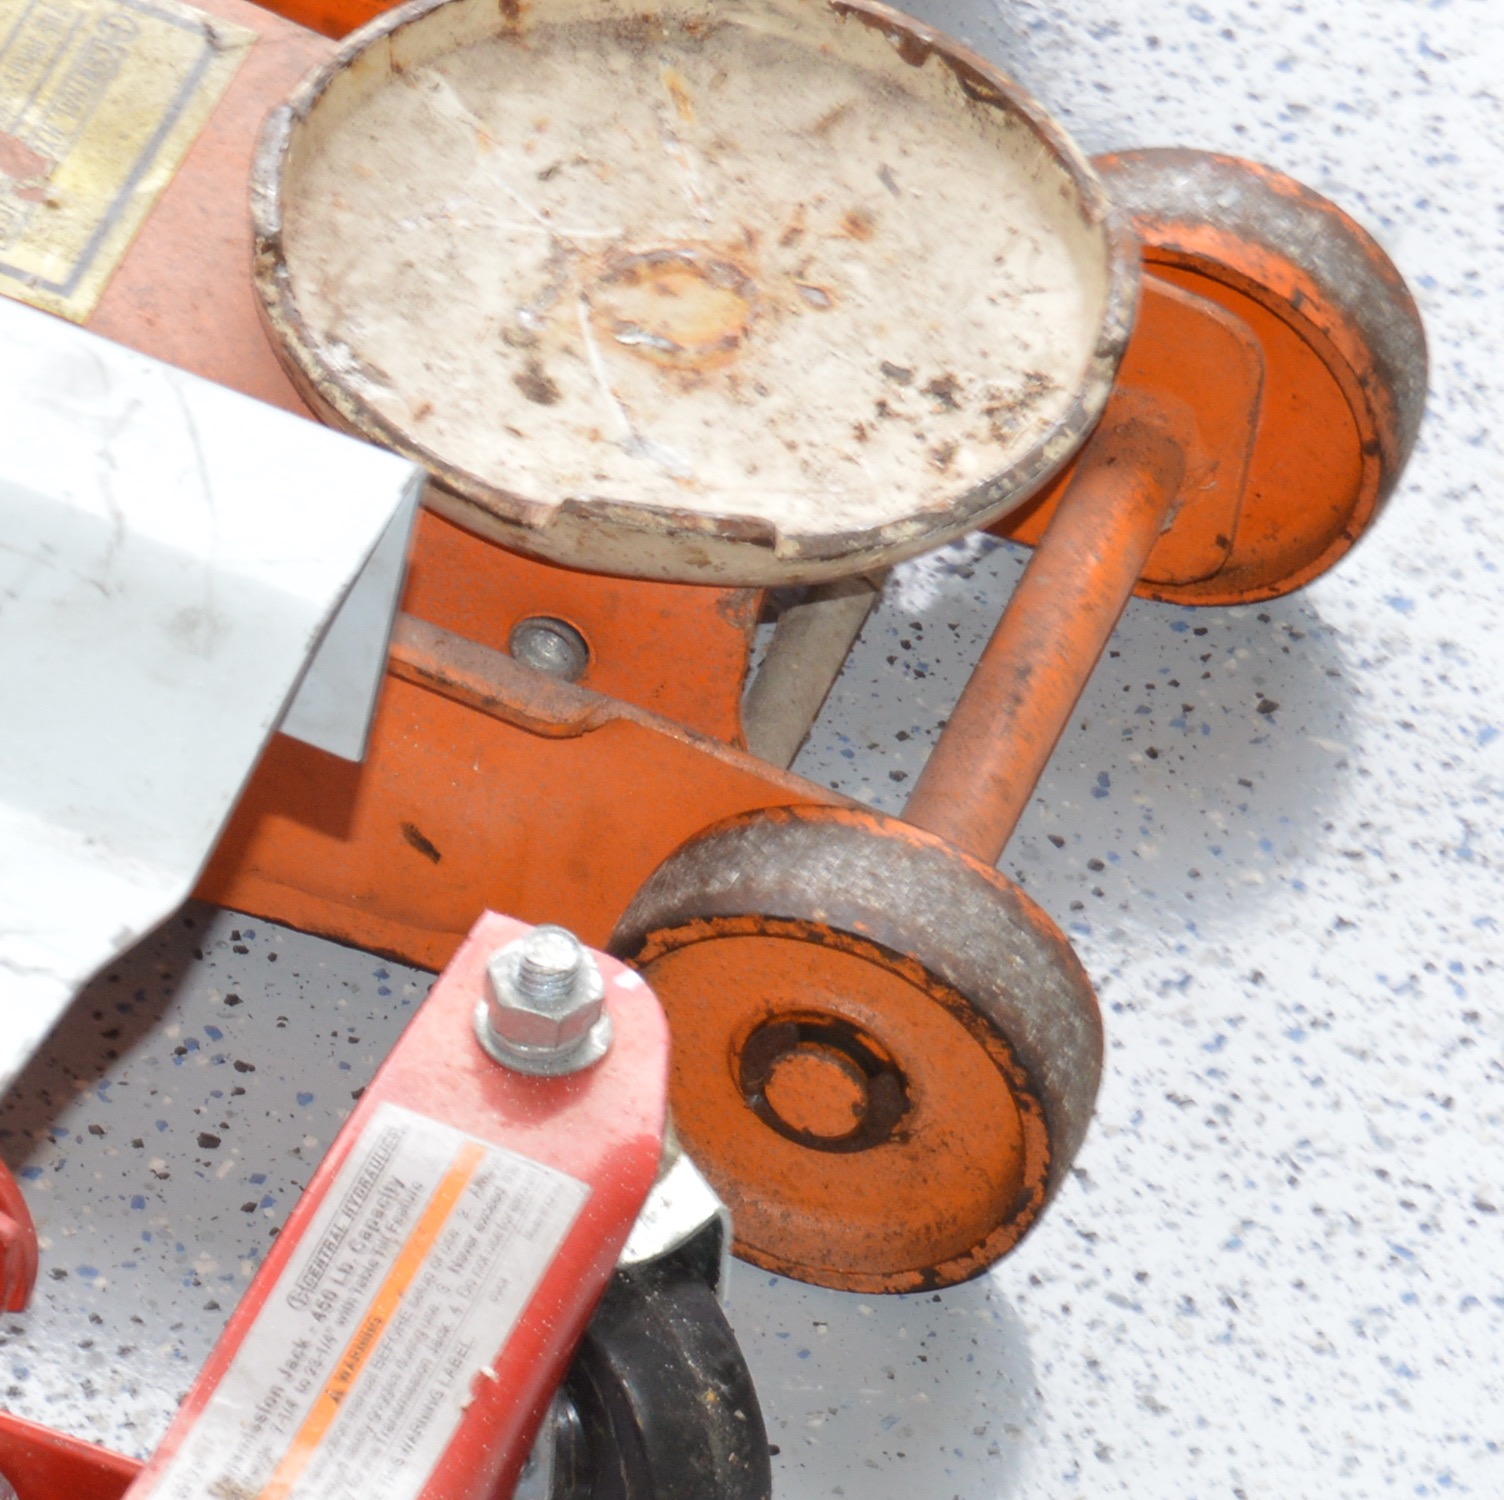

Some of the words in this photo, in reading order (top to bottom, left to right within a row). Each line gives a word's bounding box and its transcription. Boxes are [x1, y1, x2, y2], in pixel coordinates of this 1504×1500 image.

[482, 1227, 506, 1252] use
[493, 1210, 516, 1231] for
[272, 1334, 315, 1382] Jack
[305, 1286, 340, 1323] 450
[343, 1172, 409, 1256] Capacity
[291, 1376, 312, 1394] to
[329, 1294, 360, 1327] with
[347, 1256, 381, 1295] Table
[382, 1179, 425, 1233] Feature
[297, 1221, 351, 1290] CENTRAL
[453, 1275, 478, 1299] Do
[466, 1252, 491, 1278] not
[339, 1370, 379, 1420] manual
[366, 1308, 414, 1370] BEFORE
[404, 1269, 439, 1310] setup
[428, 1254, 445, 1270] or
[363, 1371, 406, 1423] goggles
[391, 1326, 431, 1373] during
[444, 1232, 480, 1274] Never
[468, 1185, 507, 1233] exceed
[332, 1314, 385, 1383] WARNING
[369, 1355, 434, 1444] Transmission
[394, 1386, 446, 1455] WARNING
